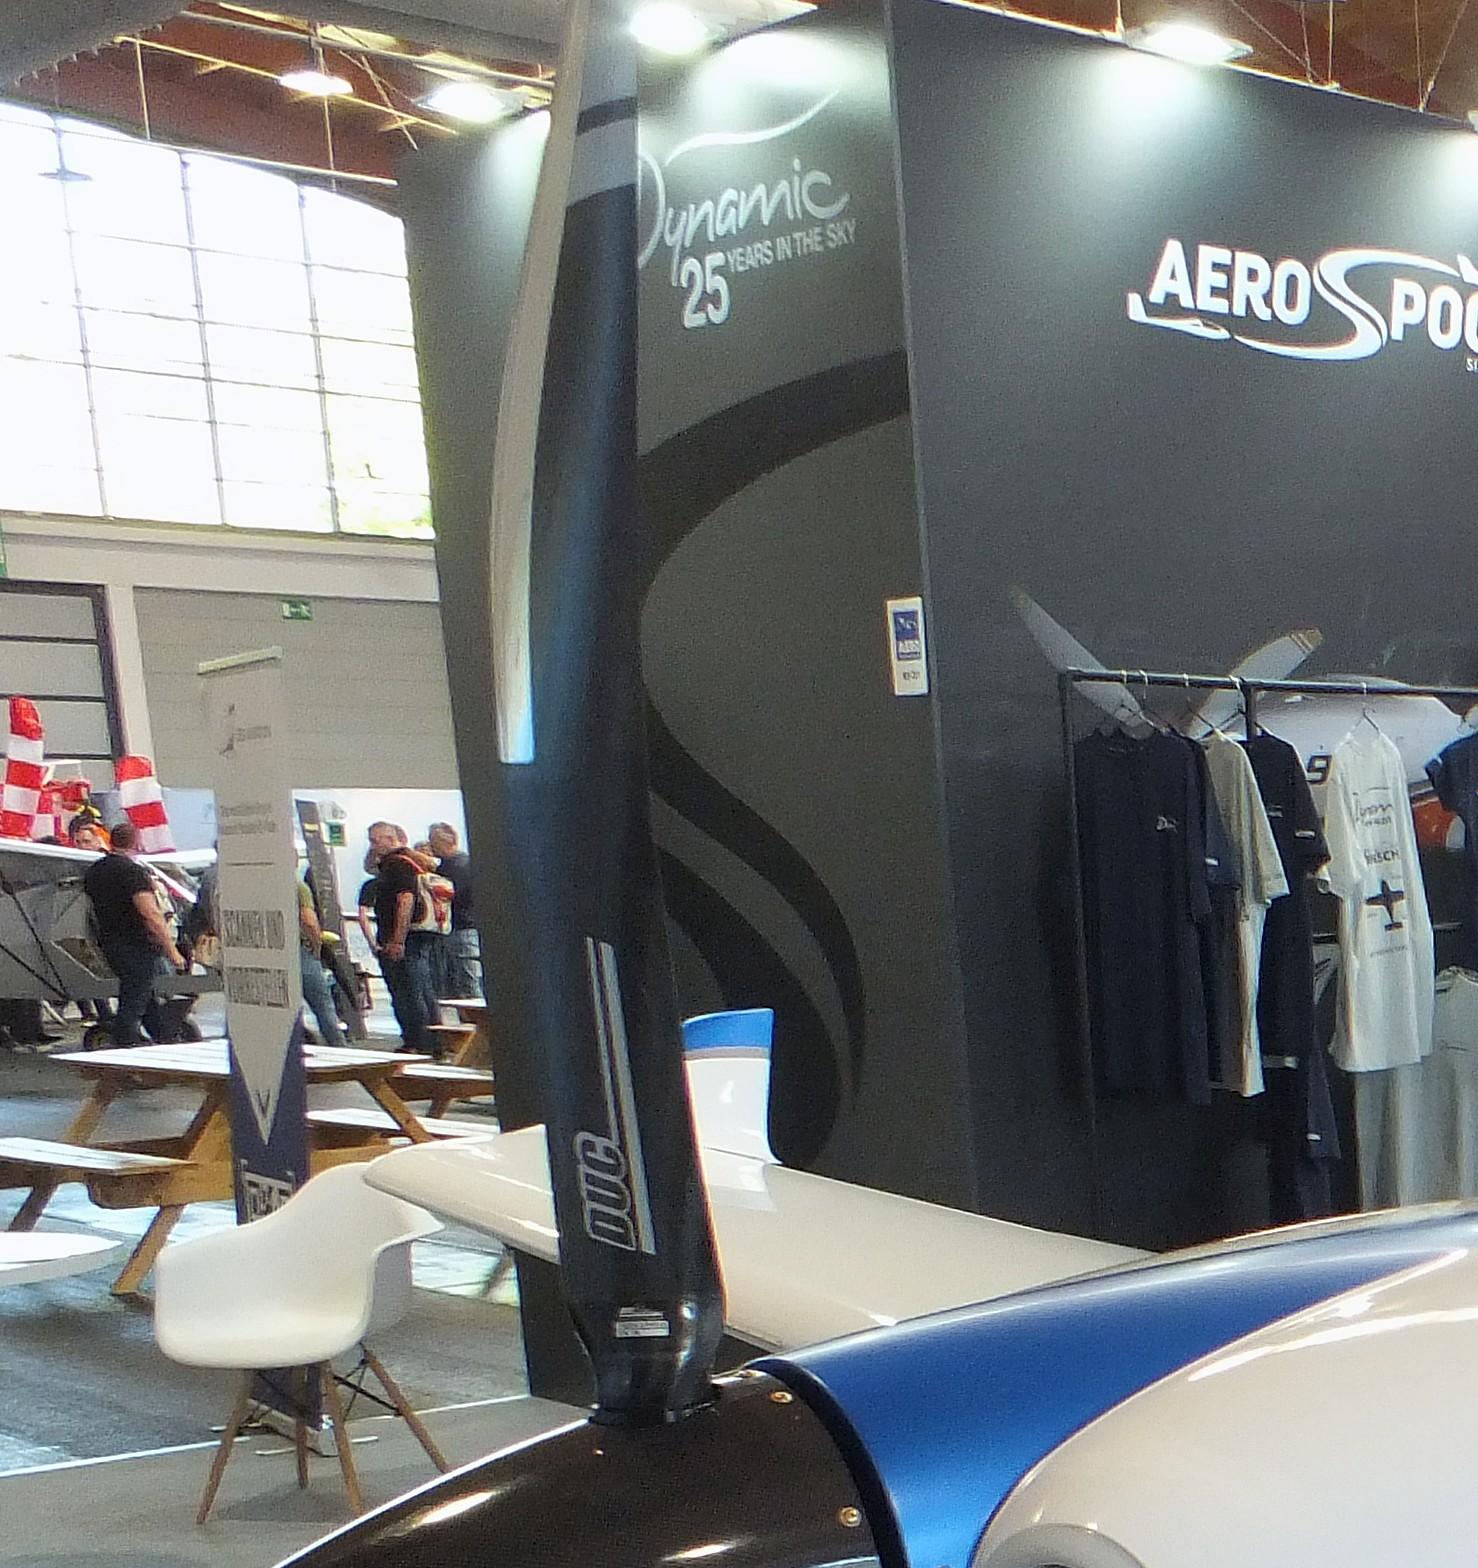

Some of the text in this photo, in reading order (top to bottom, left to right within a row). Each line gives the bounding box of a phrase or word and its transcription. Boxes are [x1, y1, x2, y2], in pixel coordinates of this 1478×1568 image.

[680, 219, 857, 329] 25 YEARS IN THE SKY
[576, 1132, 638, 1251] DUC
